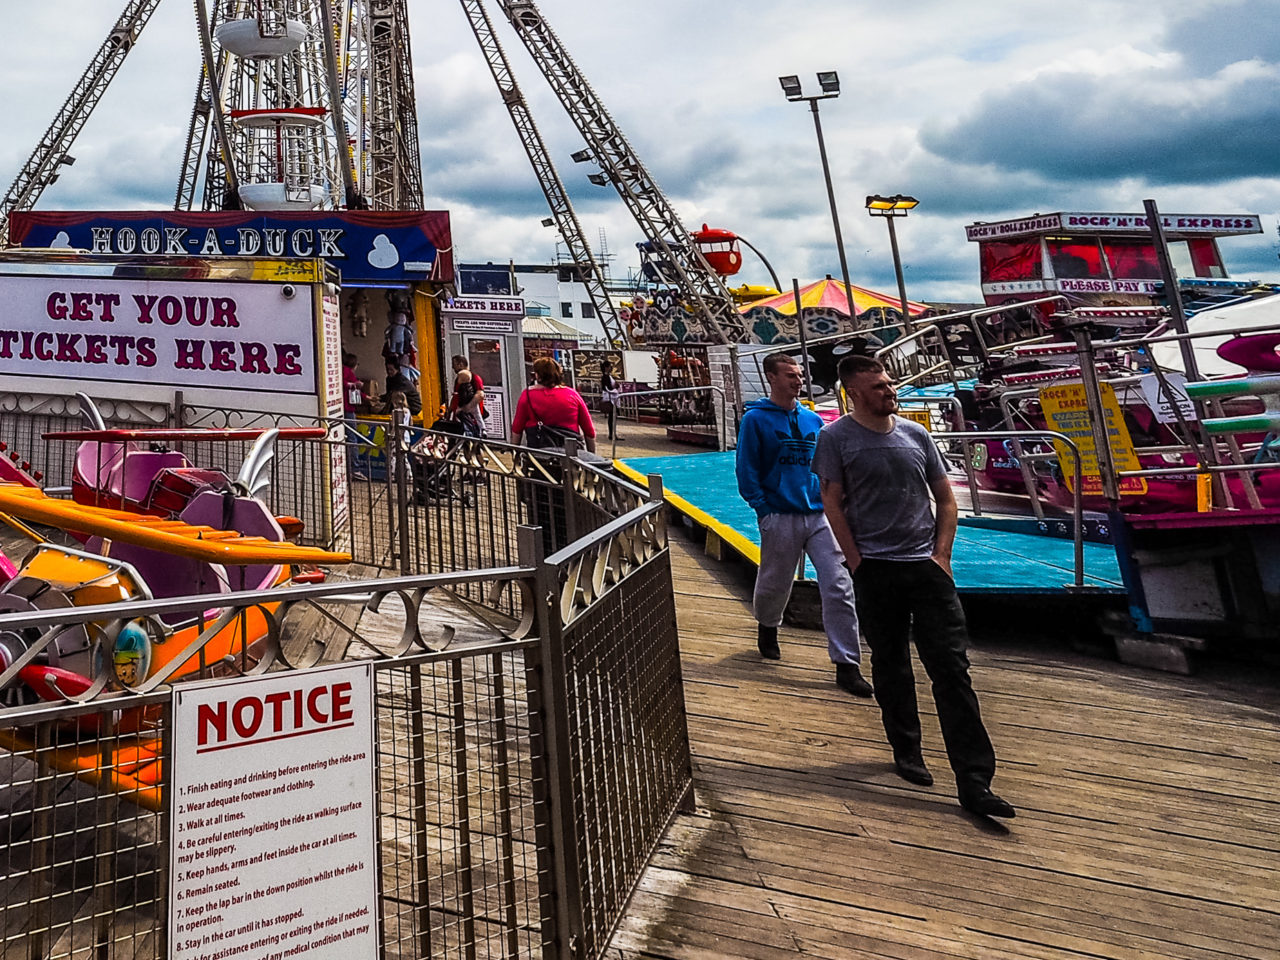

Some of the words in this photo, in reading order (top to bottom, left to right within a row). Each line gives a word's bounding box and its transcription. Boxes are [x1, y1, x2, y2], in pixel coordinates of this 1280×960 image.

[1000, 223, 1017, 233] ROLL
[1018, 218, 1058, 231] EXPRESS
[1069, 217, 1110, 226] ROCK
[1134, 218, 1171, 227] ROL
[1177, 219, 1253, 228] EXPRESS
[90, 227, 346, 257] HOOK-A-DUCK
[1061, 280, 1110, 291] PLEASE
[1116, 282, 1139, 291] PAY
[46, 291, 121, 322] GET
[132, 294, 240, 328] YOUR
[490, 302, 521, 311] HERE
[173, 338, 304, 376] HERE
[779, 455, 811, 466] adid
[197, 681, 354, 746] NOTICE
[180, 788, 186, 796] 1.
[187, 784, 209, 794] Finish
[210, 779, 232, 790] eating
[234, 775, 247, 785] and
[248, 770, 277, 782] drinking
[278, 766, 299, 777] before
[301, 760, 327, 772] entering
[329, 757, 338, 766] the
[340, 754, 351, 763] ride
[353, 752, 365, 761] area
[179, 805, 186, 814] 2.
[187, 801, 204, 812] Wear
[207, 795, 240, 809] adequate
[241, 789, 271, 801] footwear
[273, 783, 285, 792] and
[287, 779, 315, 791] clothing.
[178, 824, 185, 832] 3.
[187, 818, 204, 830] Walk
[206, 818, 212, 826] at
[214, 813, 222, 823] all
[224, 812, 245, 821] times.
[178, 842, 185, 850] 4.
[187, 839, 196, 848] Be
[198, 832, 222, 845] careful
[224, 821, 278, 840] entering/exiting
[280, 818, 291, 827] the
[292, 815, 305, 824] ride
[314, 807, 338, 819] walking
[340, 801, 362, 812] surface
[178, 854, 194, 864] may
[195, 850, 204, 859] be
[206, 844, 236, 858] slippery.
[178, 873, 184, 882] 5.
[186, 869, 204, 880] Keep
[206, 863, 230, 875] hands,
[231, 860, 248, 869] arms
[250, 853, 262, 864] and
[264, 853, 277, 861] feet
[279, 847, 298, 857] inside
[300, 843, 310, 851] the
[311, 840, 321, 849] car
[322, 838, 329, 846] at
[339, 831, 357, 841] times.
[177, 892, 184, 900] 6.
[186, 885, 213, 898] Remain
[215, 877, 240, 890] seated.
[177, 910, 184, 919] 7.
[186, 905, 204, 917] Keep
[206, 901, 217, 911] the
[219, 897, 230, 908] lap
[232, 893, 244, 903] bar
[245, 893, 252, 901] in
[254, 889, 265, 899] the
[266, 884, 285, 896] down
[286, 877, 313, 892] position
[314, 870, 333, 882] whilst
[335, 867, 344, 876] the
[346, 864, 358, 873] ride
[359, 861, 364, 870] is
[176, 943, 183, 952] 8.
[185, 939, 201, 950] Stay
[203, 936, 210, 945] in
[212, 932, 223, 942] the
[225, 929, 236, 938] car
[237, 922, 254, 935] until
[255, 921, 260, 930] it
[262, 918, 273, 928] has
[275, 908, 304, 924] stopped.
[177, 923, 183, 933] in
[186, 915, 224, 932] operation.
[212, 944, 248, 960] assistance
[250, 934, 279, 950] entering
[280, 932, 288, 940] or
[290, 925, 312, 938] exiting
[313, 921, 324, 930] the
[325, 917, 338, 927] ride
[339, 913, 343, 922] if
[345, 906, 369, 920] needed.
[271, 952, 282, 960] any
[284, 941, 310, 958] medical
[311, 933, 341, 948] condition
[343, 929, 355, 939] that
[357, 924, 370, 934] may
